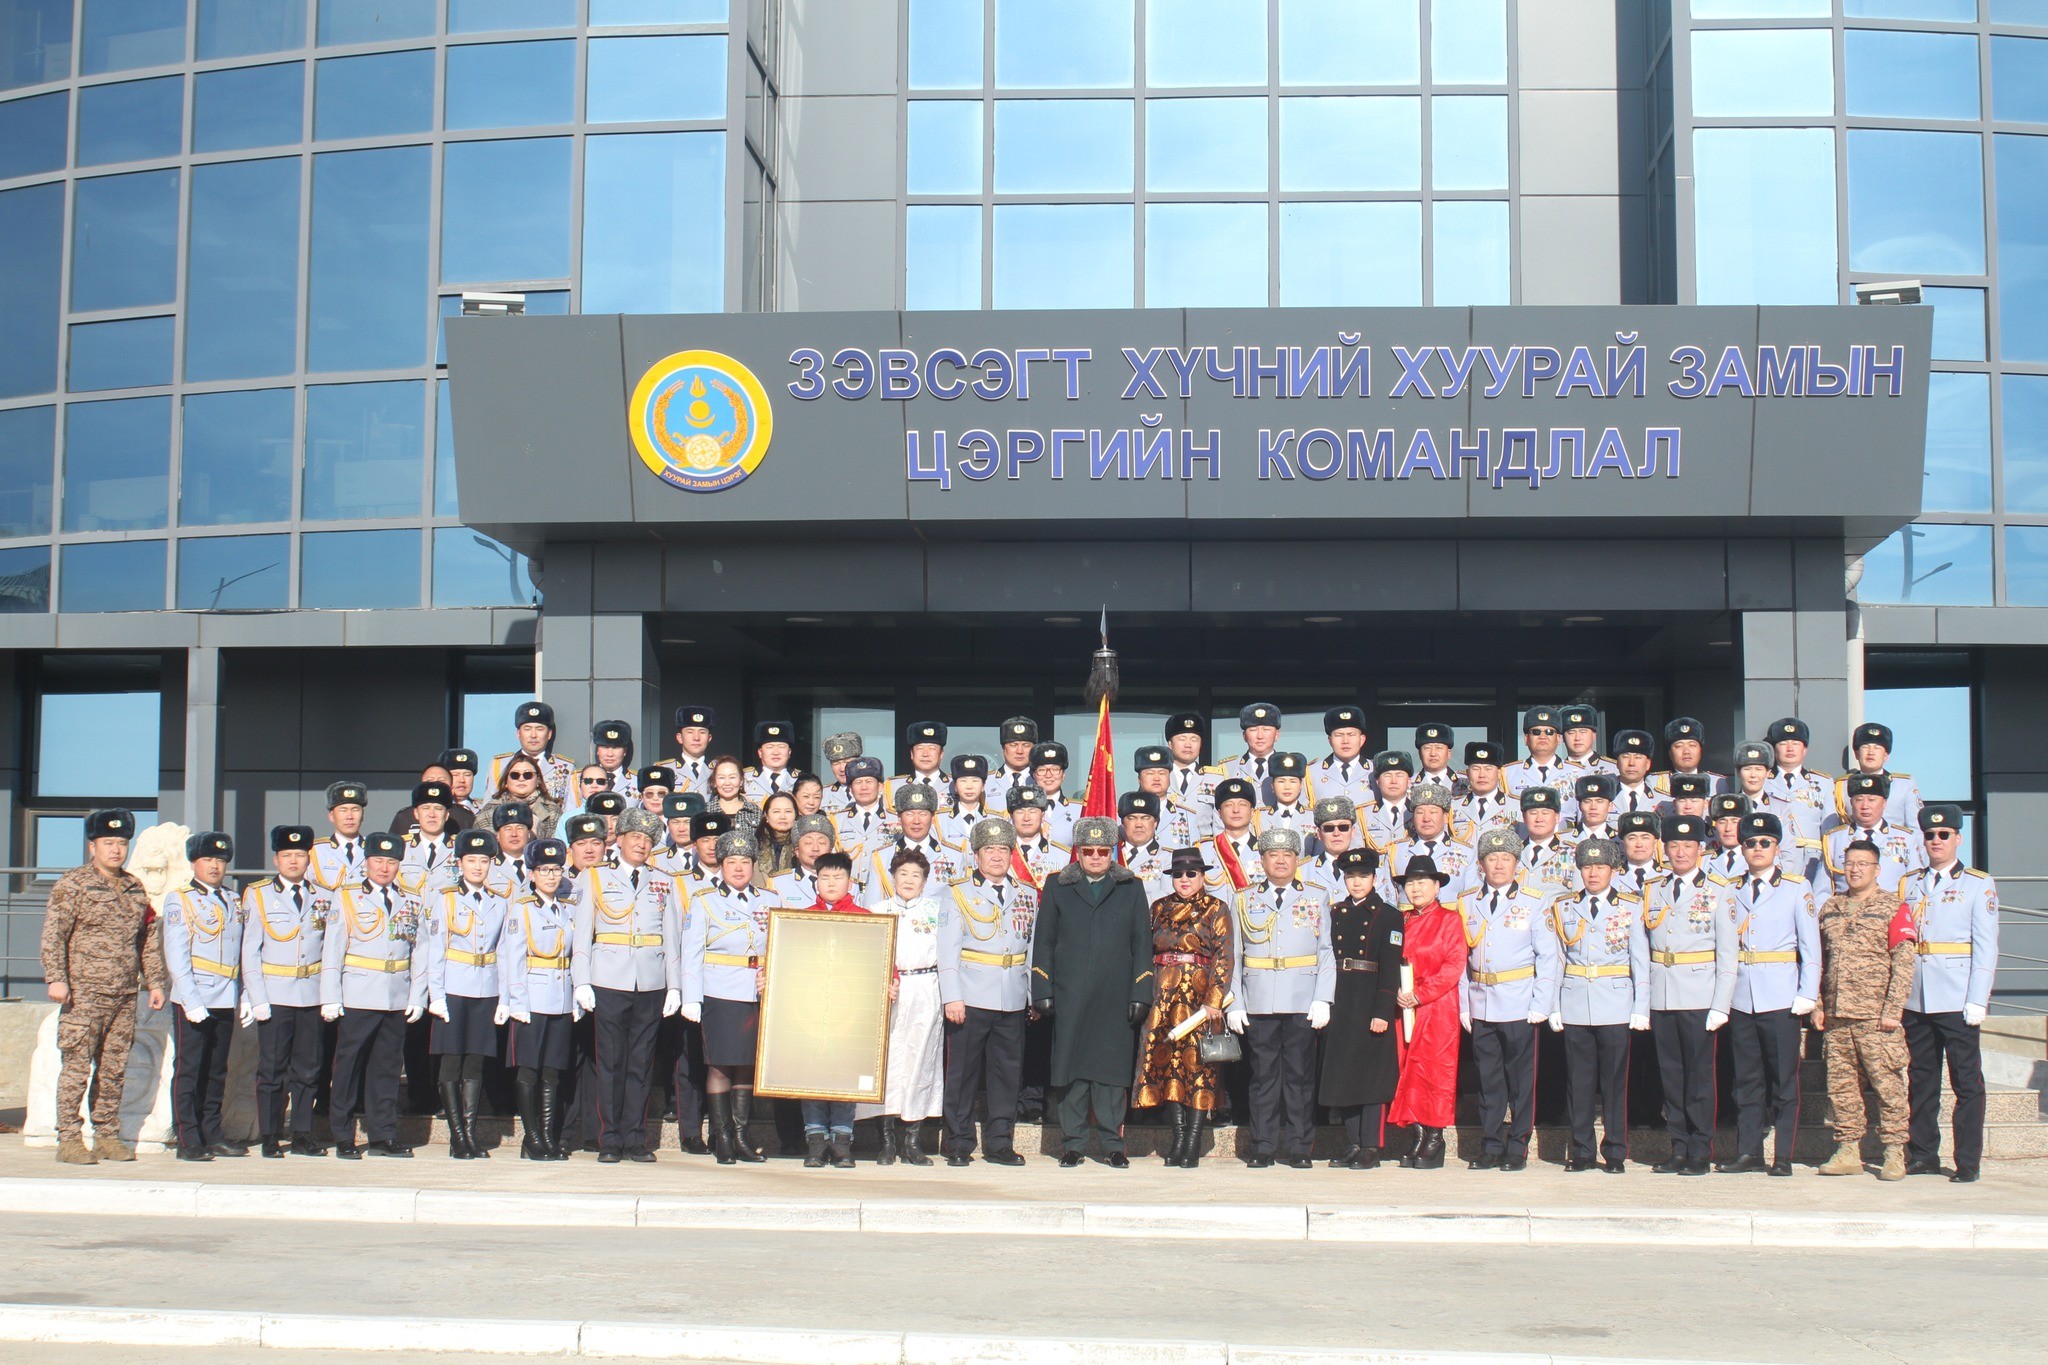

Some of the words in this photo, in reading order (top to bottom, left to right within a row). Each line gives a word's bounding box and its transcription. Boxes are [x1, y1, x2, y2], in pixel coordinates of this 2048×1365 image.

[787, 347, 1092, 399] ЗЭВСЭГТ
[1120, 331, 1371, 398] ХҮЧНИЙ
[1389, 331, 1647, 398] ХУУРАЙ
[1667, 344, 1904, 398] ЗАМЫН
[663, 470, 691, 486] ХУУРАЙ
[692, 479, 720, 488] ЗАМЫН
[720, 468, 742, 485] ЦЭРЭГ
[906, 413, 1221, 489] ЦЭРГИЙН
[1258, 427, 1682, 488] КОМАНДЛАЛ
